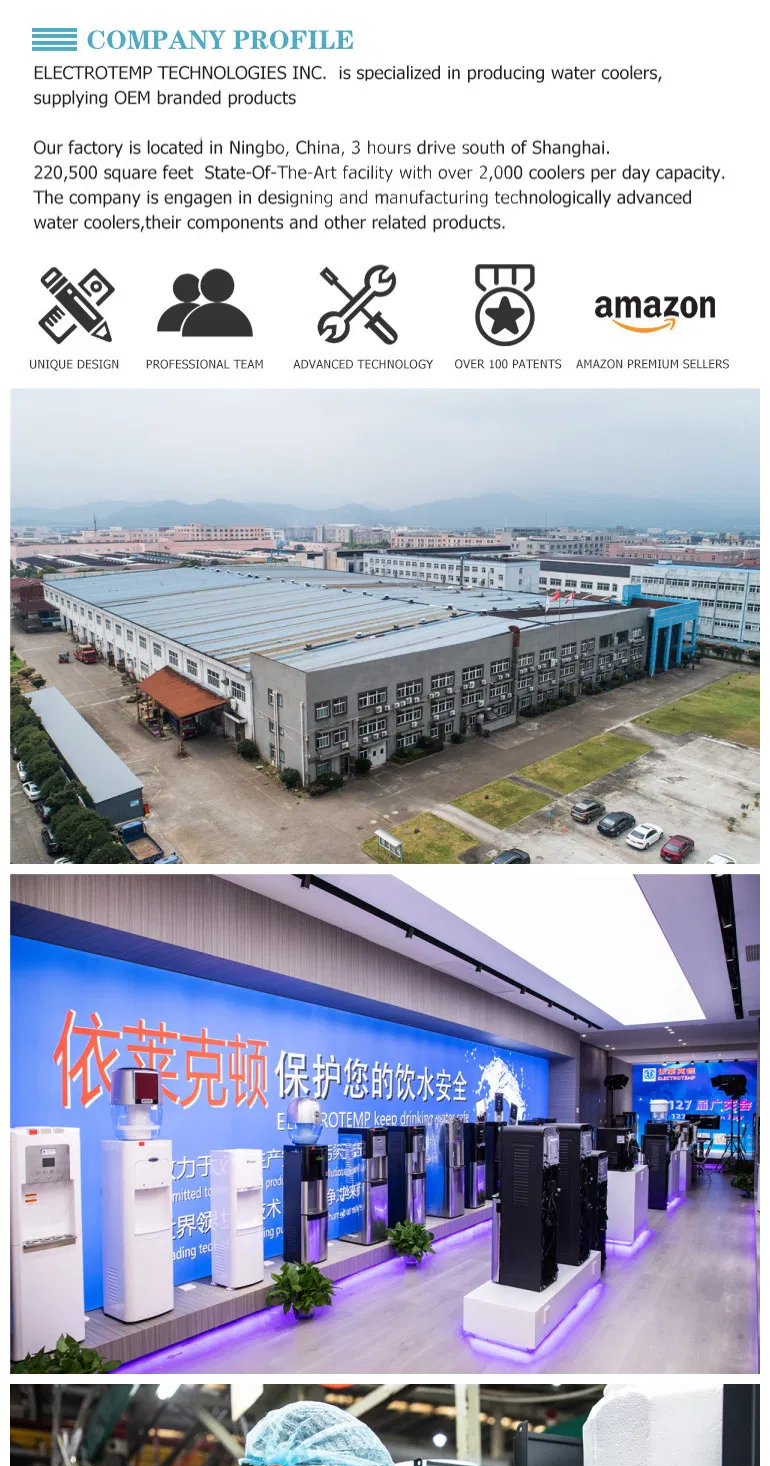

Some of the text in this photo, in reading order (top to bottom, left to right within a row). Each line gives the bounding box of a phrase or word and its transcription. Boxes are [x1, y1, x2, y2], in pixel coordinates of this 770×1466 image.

[53, 1009, 467, 1109] 依莱克顿 保护您的饮水安全
[374, 1110, 397, 1126] keep
